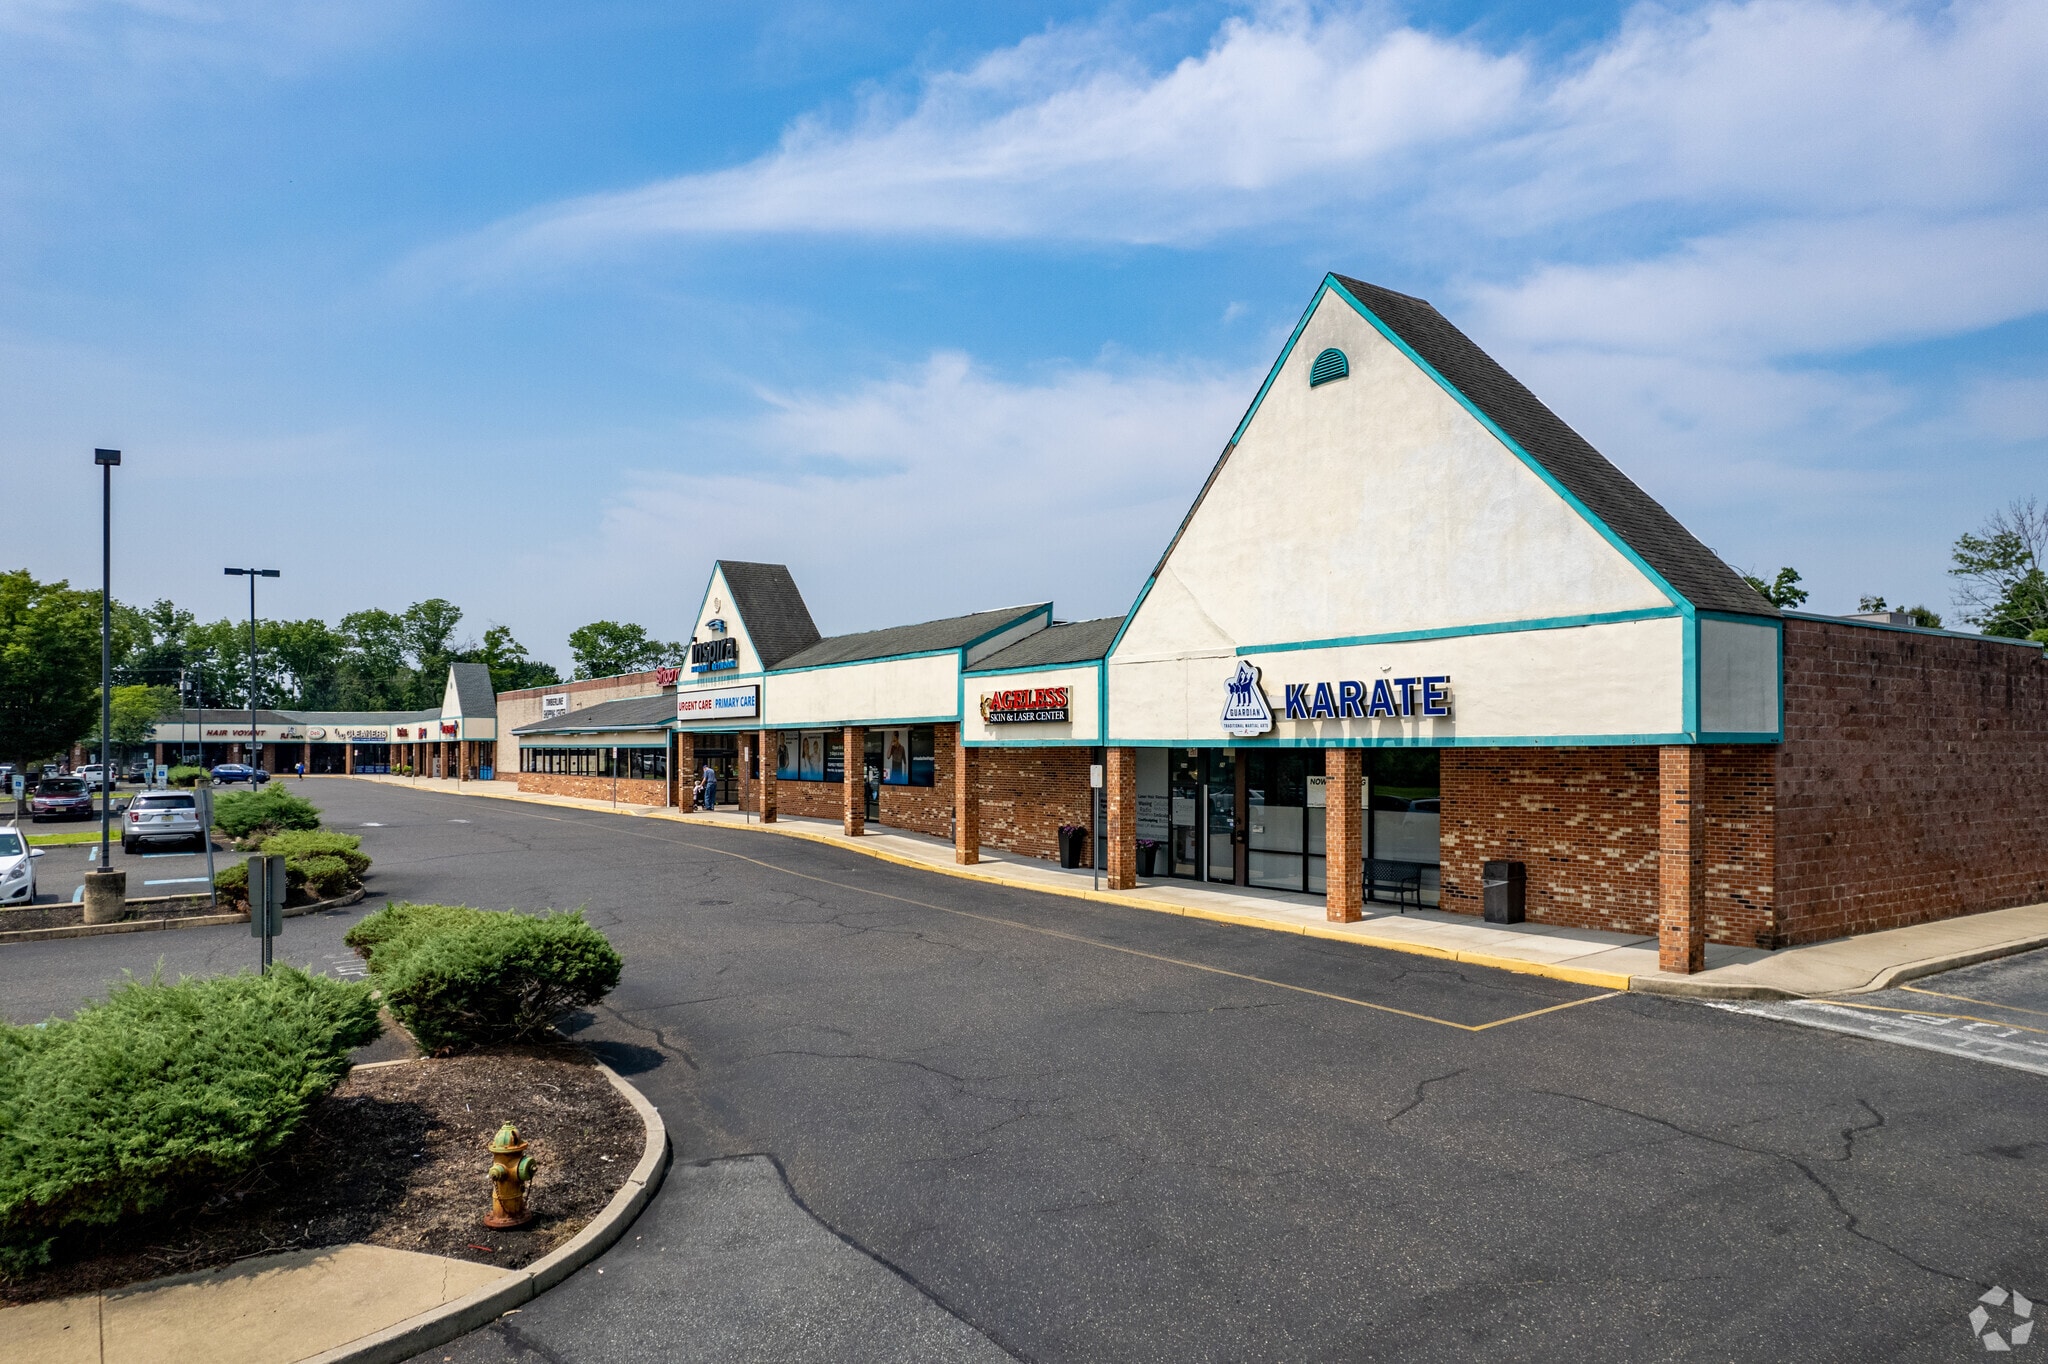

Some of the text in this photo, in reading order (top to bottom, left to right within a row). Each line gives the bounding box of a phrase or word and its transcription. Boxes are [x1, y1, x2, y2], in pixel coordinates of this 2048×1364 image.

[691, 637, 736, 671] inspira
[679, 695, 755, 711] URGENT CARE PRIMARY CARE
[989, 687, 1066, 710] AGELESS
[1285, 675, 1449, 720] KARATE
[990, 710, 1065, 722] SKIN & LASER CENTER
[1229, 708, 1261, 717] GUARDIAN
